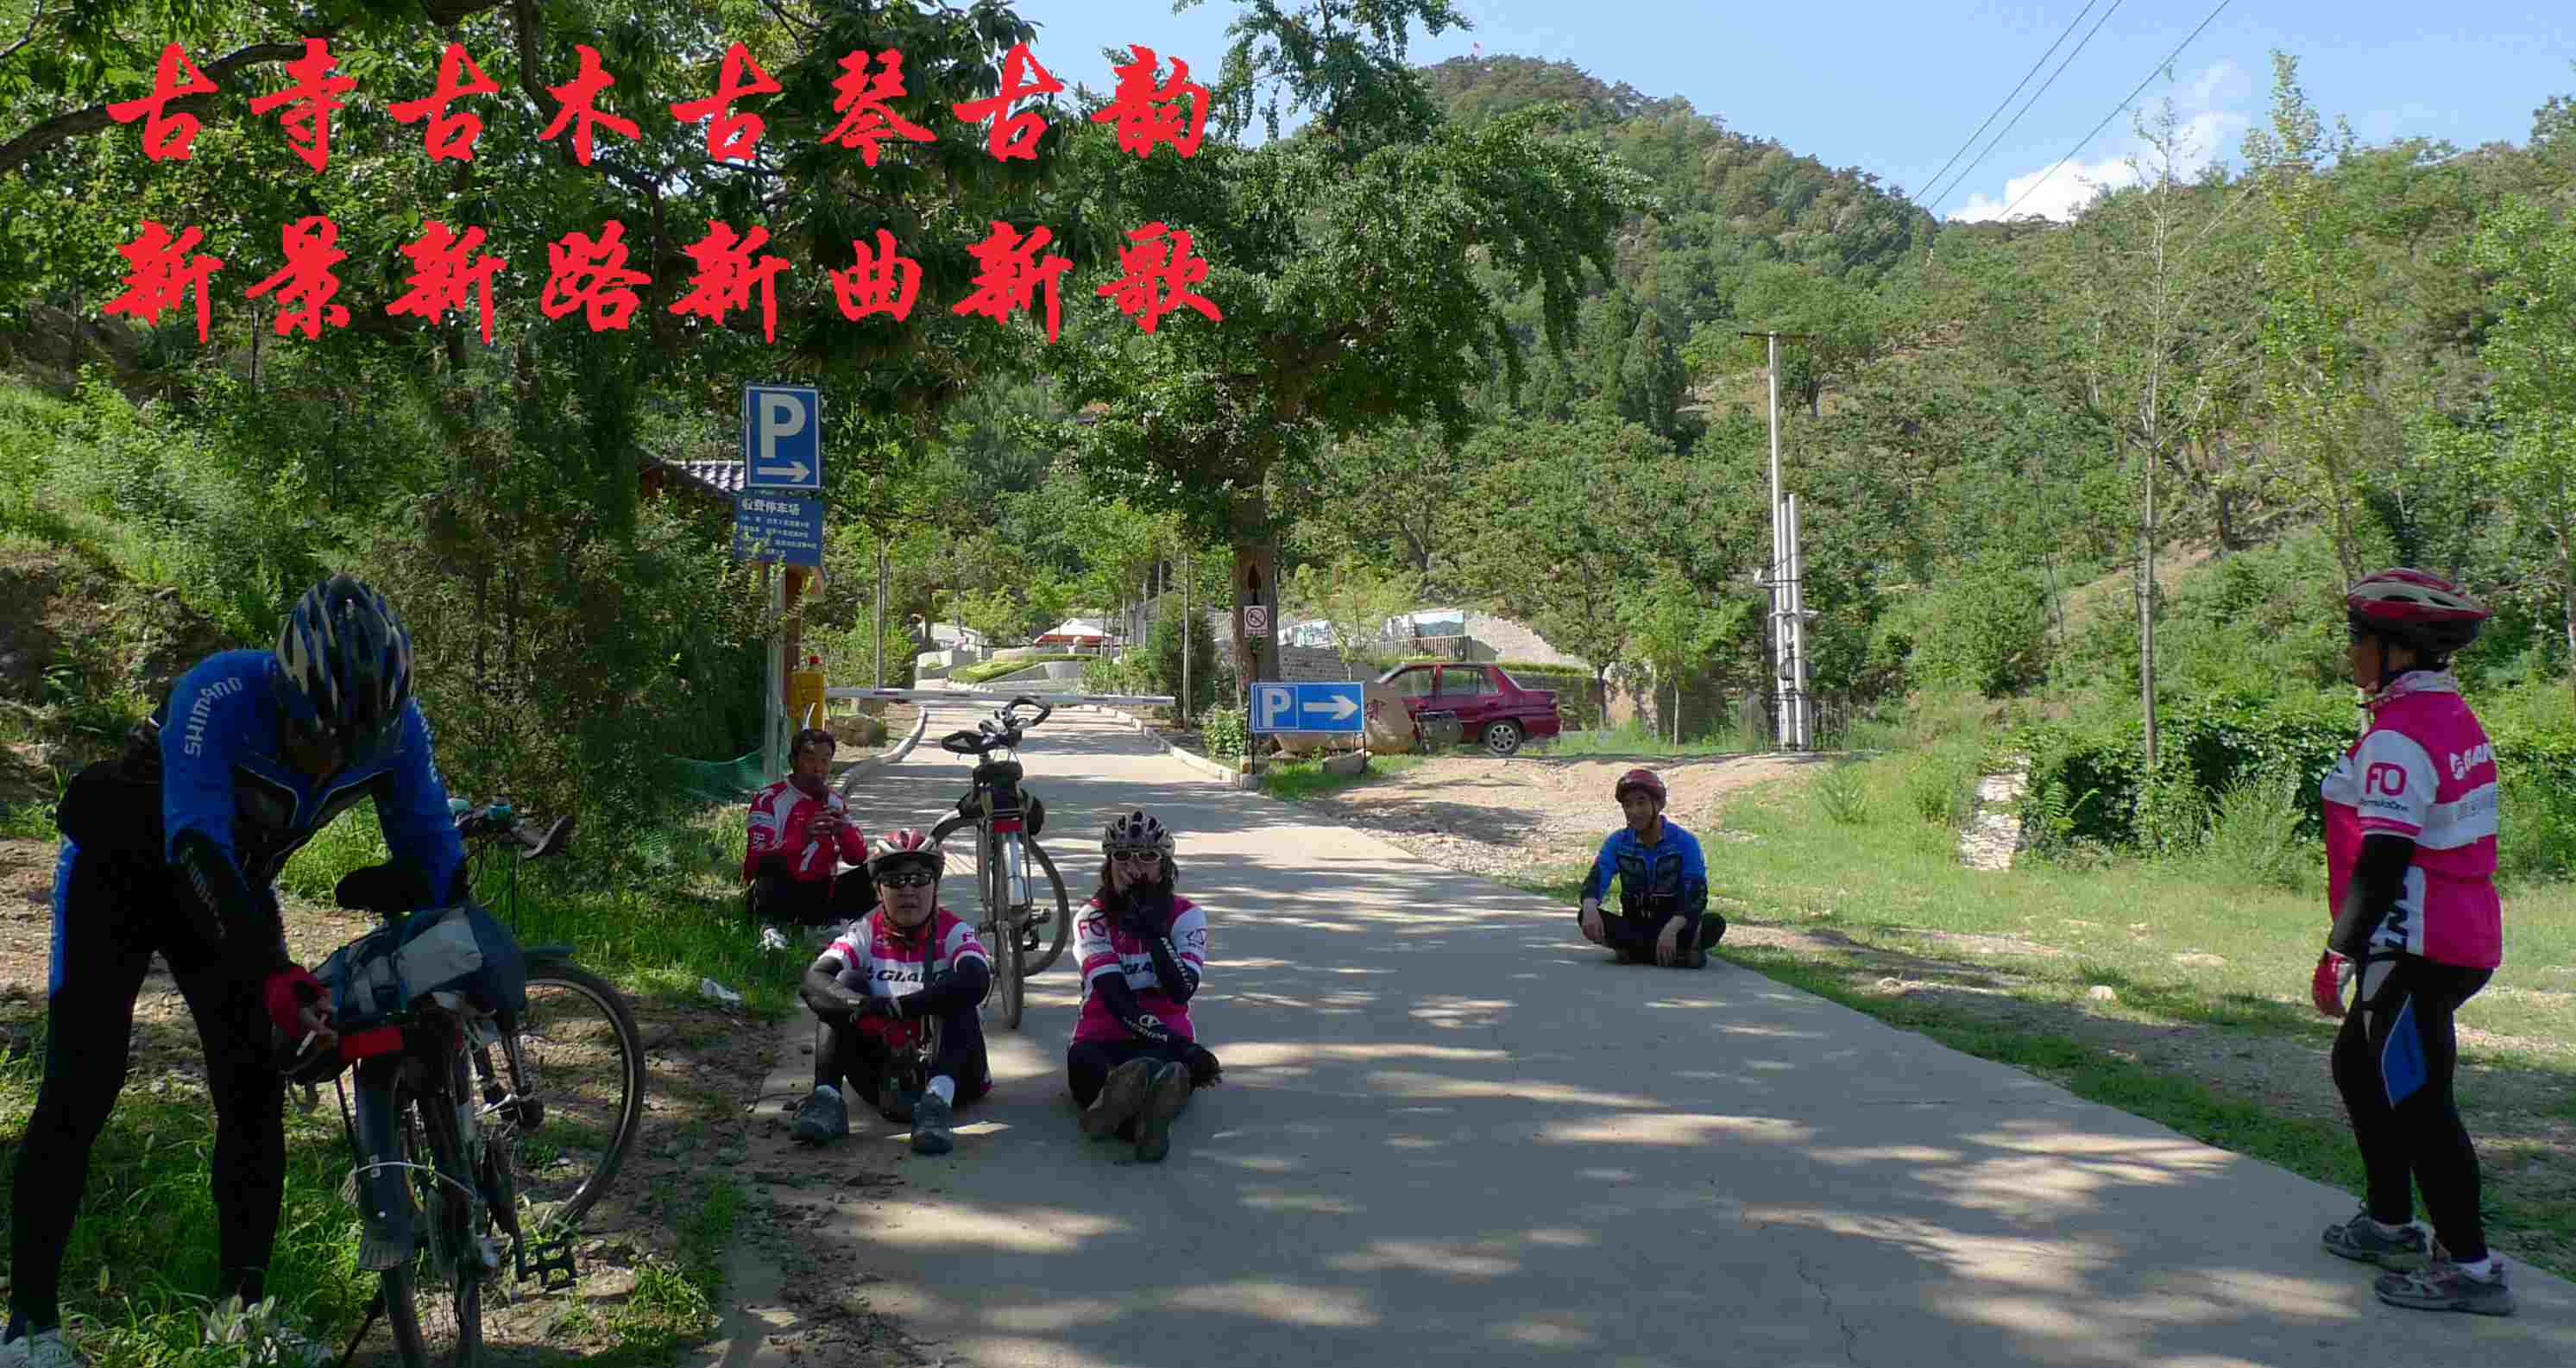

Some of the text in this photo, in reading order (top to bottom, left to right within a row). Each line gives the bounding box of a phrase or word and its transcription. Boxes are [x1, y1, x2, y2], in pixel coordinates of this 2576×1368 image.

[759, 393, 806, 458] P
[184, 677, 242, 758] SHIMANO
[1262, 688, 1292, 728] P
[2365, 762, 2408, 797] FO
